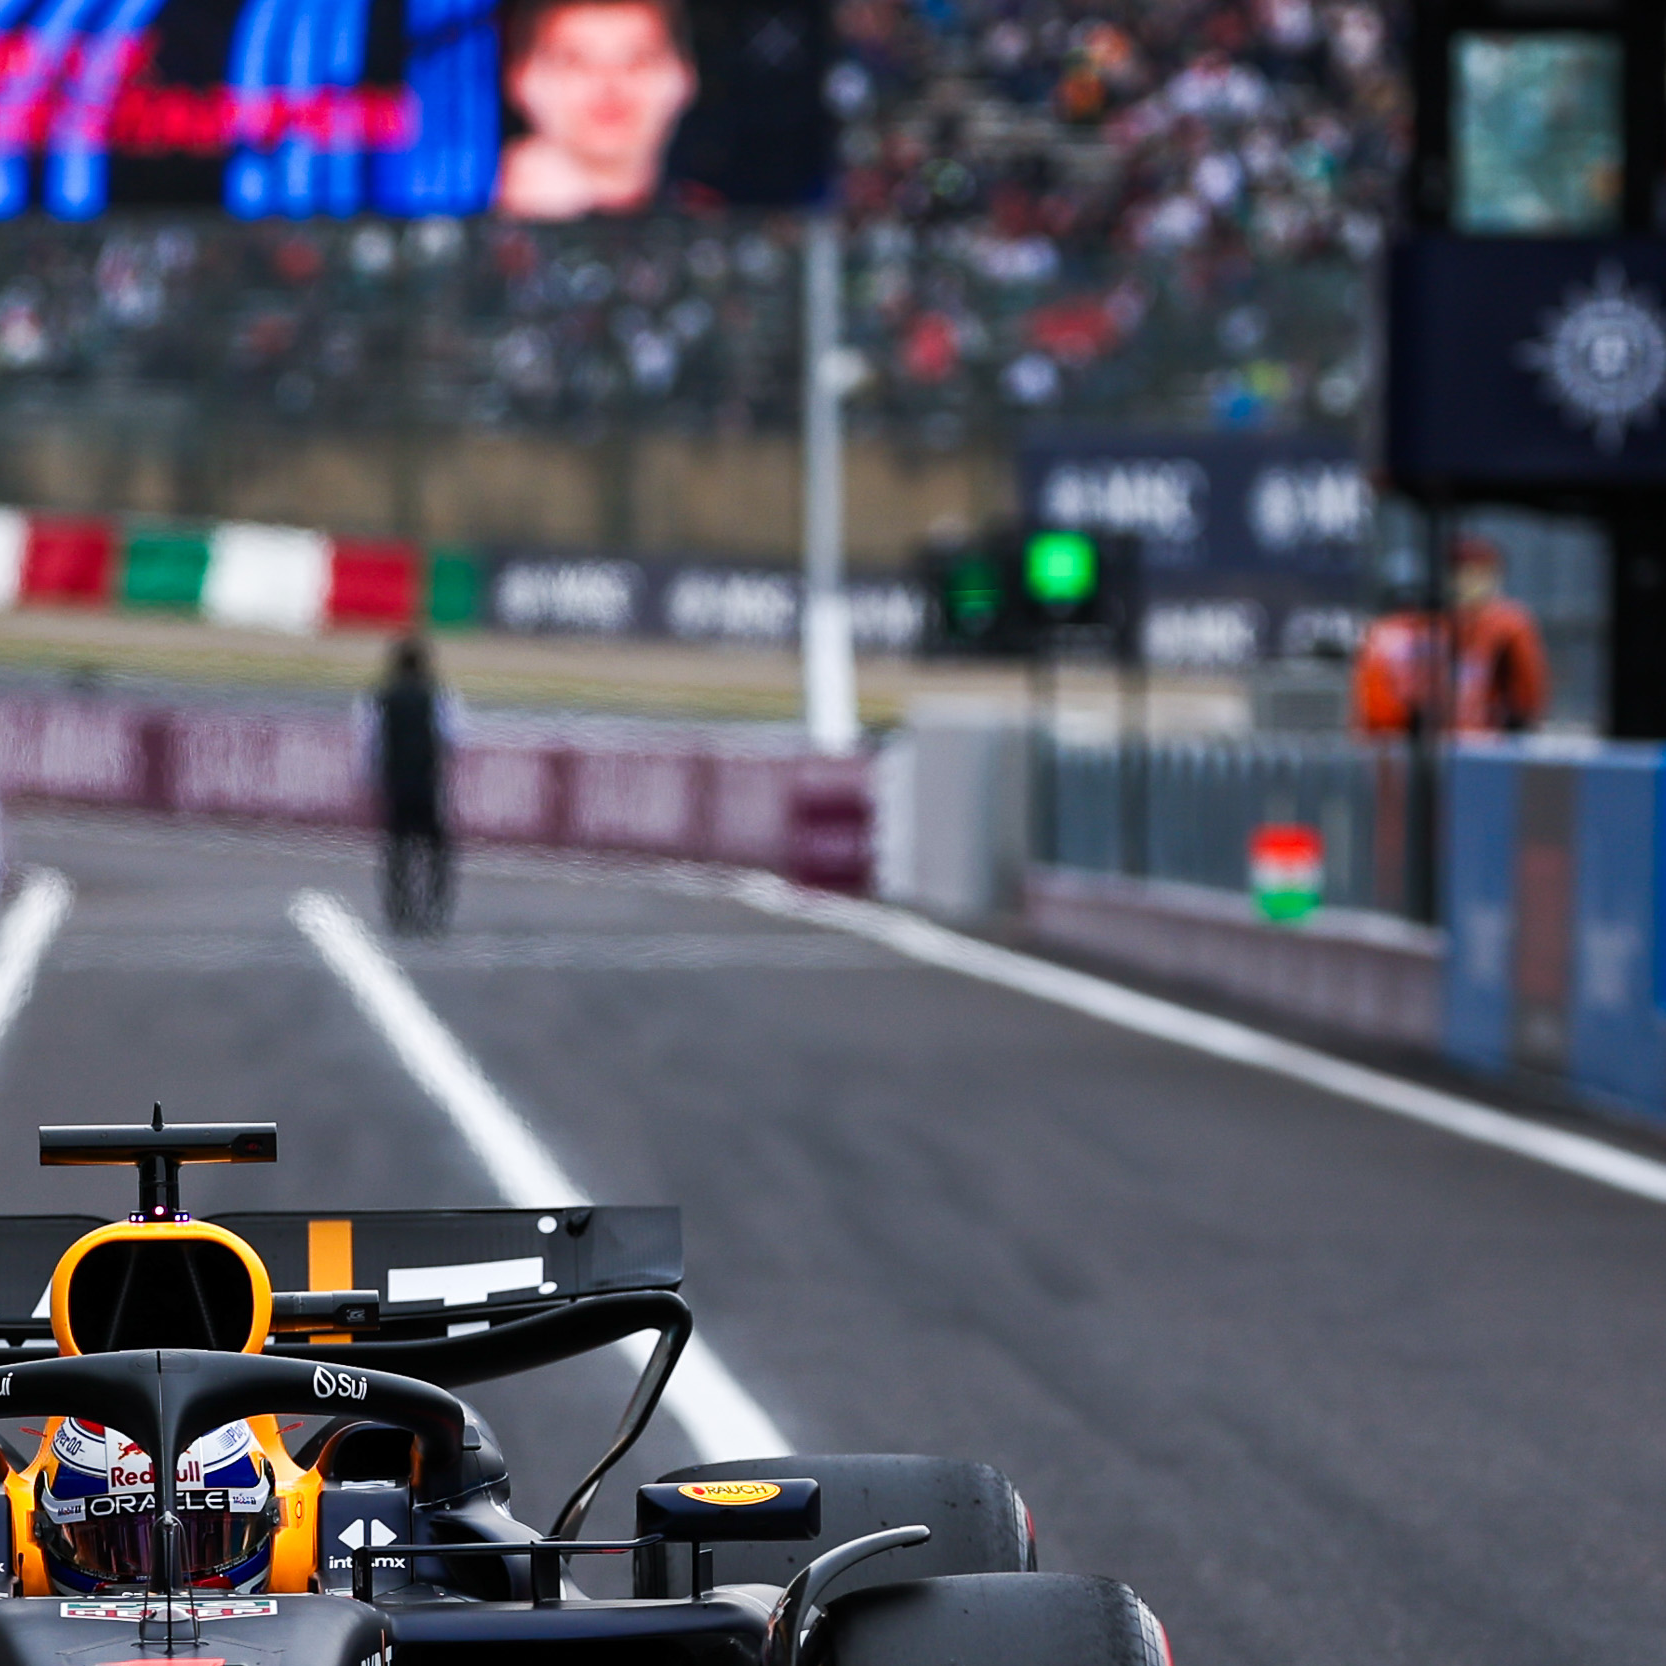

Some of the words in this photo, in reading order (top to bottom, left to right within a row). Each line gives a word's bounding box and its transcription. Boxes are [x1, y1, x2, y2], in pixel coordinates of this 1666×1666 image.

[337, 1372, 368, 1401] Sui
[110, 1461, 156, 1488] Red
[175, 1460, 201, 1483] ull
[704, 1484, 768, 1495] RAUCH
[90, 1490, 226, 1517] ORALE
